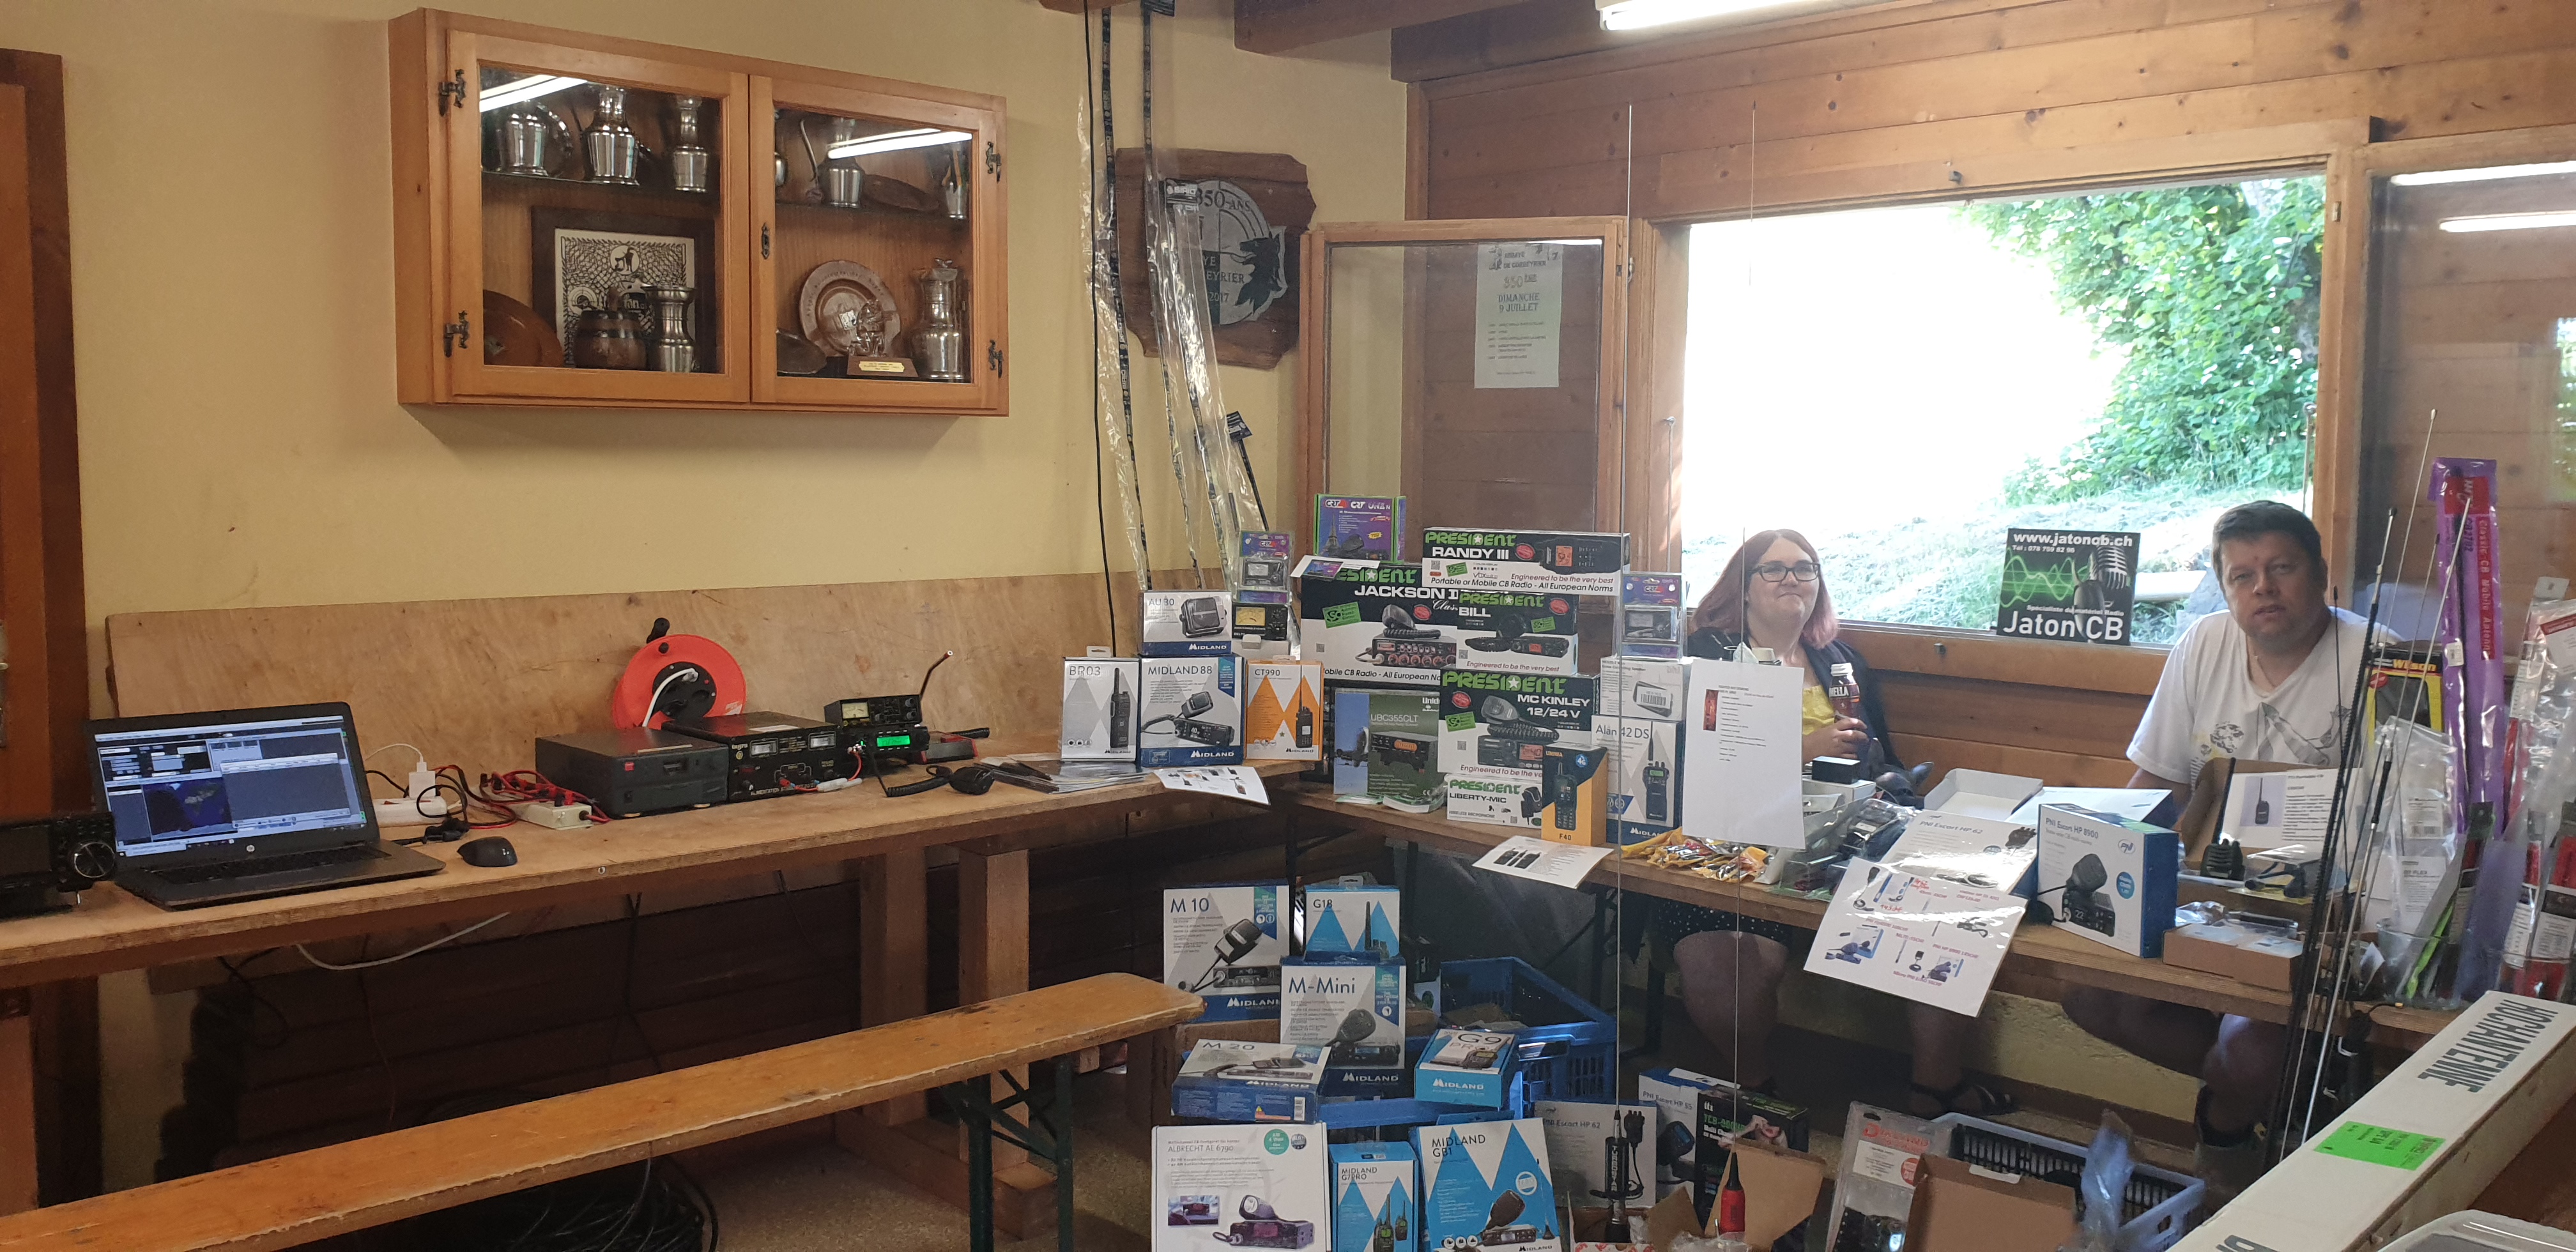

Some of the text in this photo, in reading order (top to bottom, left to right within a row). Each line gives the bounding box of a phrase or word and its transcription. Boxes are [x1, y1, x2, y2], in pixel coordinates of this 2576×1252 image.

[1206, 271, 1245, 284] EYRIER
[1498, 292, 1540, 303] DIMANCHE
[1506, 302, 1539, 312] JUILLET
[1425, 531, 1517, 547] PRESIDENT
[1432, 546, 1494, 559] RANDY
[1338, 569, 1417, 584] ESIDENT
[1511, 573, 1549, 583] Engineered
[1431, 577, 1462, 585] Portable
[1510, 580, 1532, 588] Radio
[1550, 583, 1586, 592] European
[1588, 584, 1614, 592] Norms
[1354, 584, 1445, 600] JACKSON
[1459, 593, 1545, 607] PRESIDENT
[1459, 606, 1491, 617] BILL
[2003, 611, 2124, 641] Jaton CB
[1148, 666, 1213, 675] MIDLAND 88
[1393, 671, 1429, 682] European
[1442, 671, 1567, 694] PRESIDENT
[1518, 694, 1590, 707] MC KINLEY
[1370, 714, 1418, 722] UBC355CLT
[1527, 707, 1581, 719] 12/24 V
[1596, 724, 1650, 739] Alan 42 DS
[1460, 765, 1501, 775] Engineered
[1450, 779, 1522, 795] PRESIDENT
[1449, 793, 1507, 804] LIBERTY-MIC
[2045, 817, 2056, 826] PNI
[2057, 821, 2073, 832] Escort
[2074, 825, 2083, 834] HP
[2083, 828, 2099, 839] 8900
[1170, 897, 1209, 913] M 10
[1313, 898, 1333, 909] G18
[1288, 976, 1356, 994] M-Mini
[1227, 997, 1280, 1008] MIDLAN
[2418, 998, 2559, 1093] HOCHANTENNE
[1342, 1072, 1399, 1082] MIDLAND
[1246, 1080, 1310, 1088] MIDLAND
[1432, 1078, 1484, 1090] MIDLAND
[1432, 1134, 1486, 1148] MIDLAND
[1216, 1145, 1234, 1153] 6790
